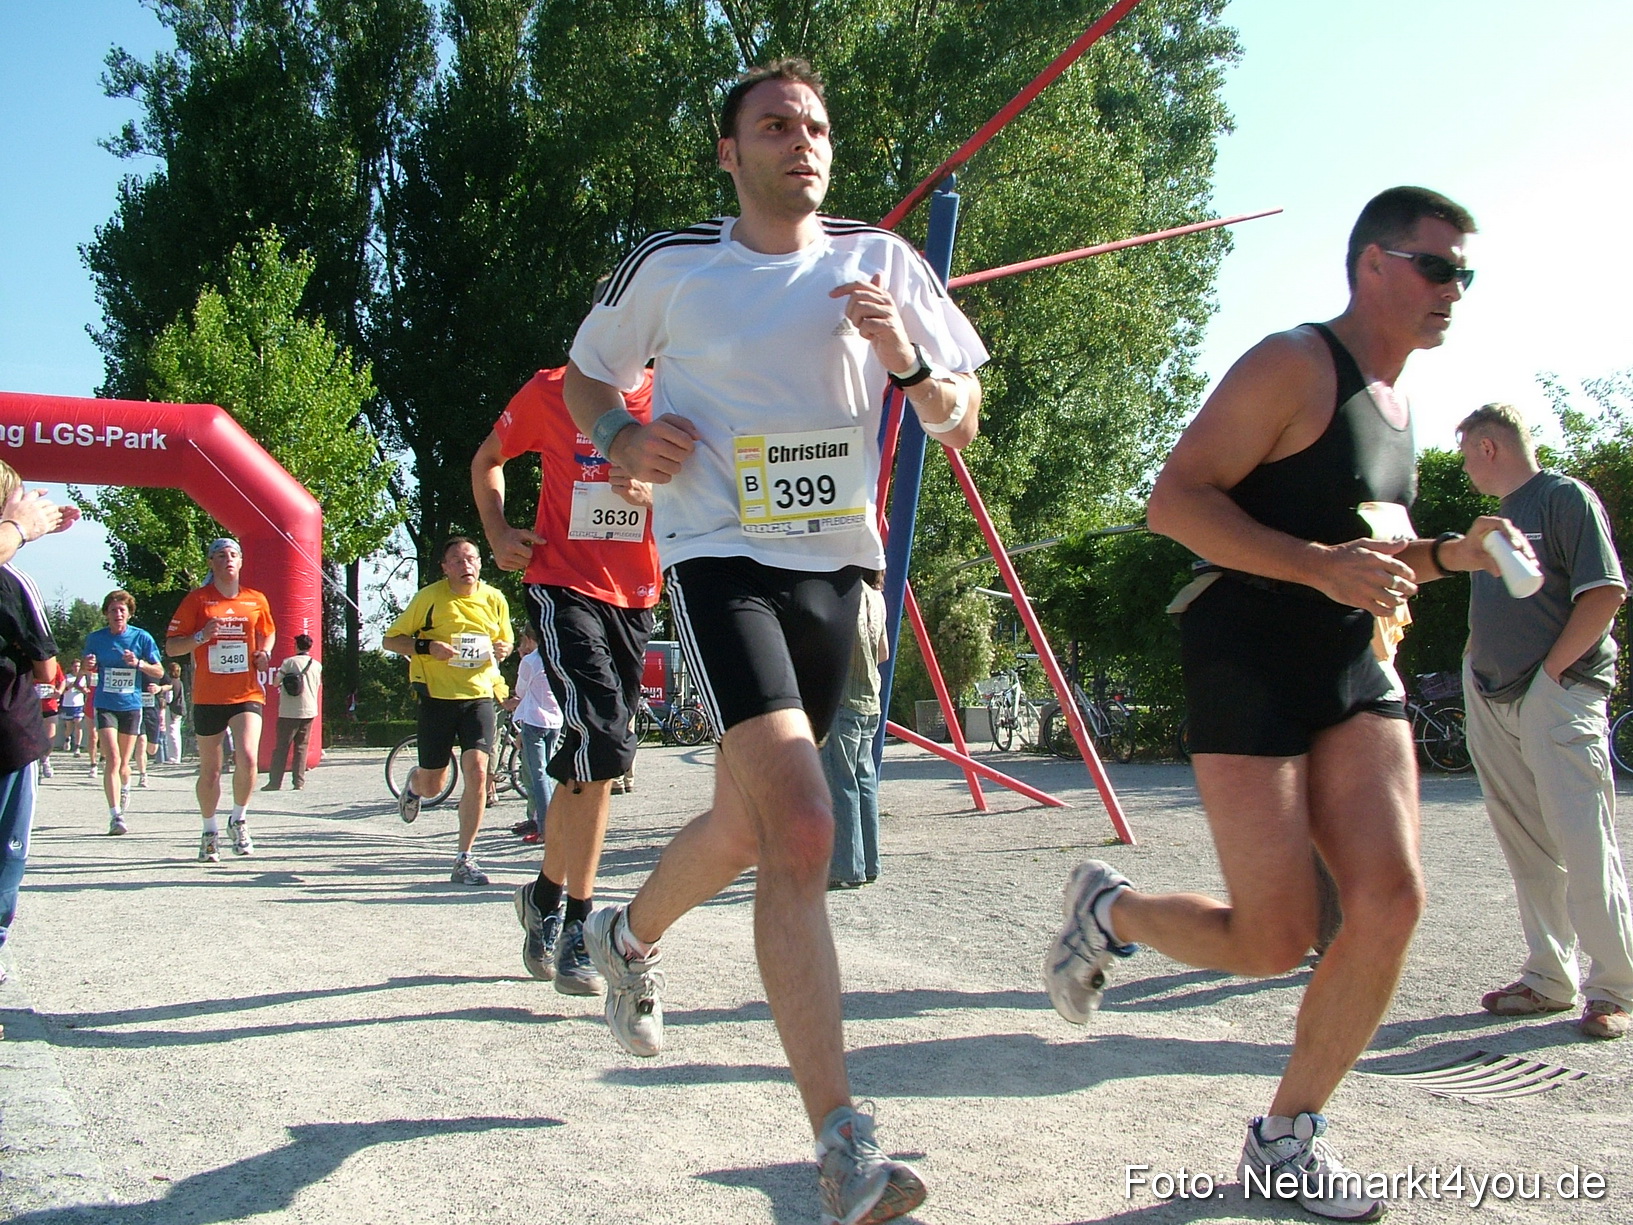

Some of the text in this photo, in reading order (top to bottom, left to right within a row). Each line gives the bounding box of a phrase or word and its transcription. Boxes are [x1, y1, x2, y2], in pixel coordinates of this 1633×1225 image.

[35, 422, 167, 450] LGS-Park
[768, 442, 849, 464] Christian
[745, 476, 759, 492] B
[774, 474, 836, 509] 399
[592, 508, 639, 526] 3630
[220, 654, 245, 665] 3480
[461, 648, 480, 659] 741
[112, 678, 134, 687] 2076
